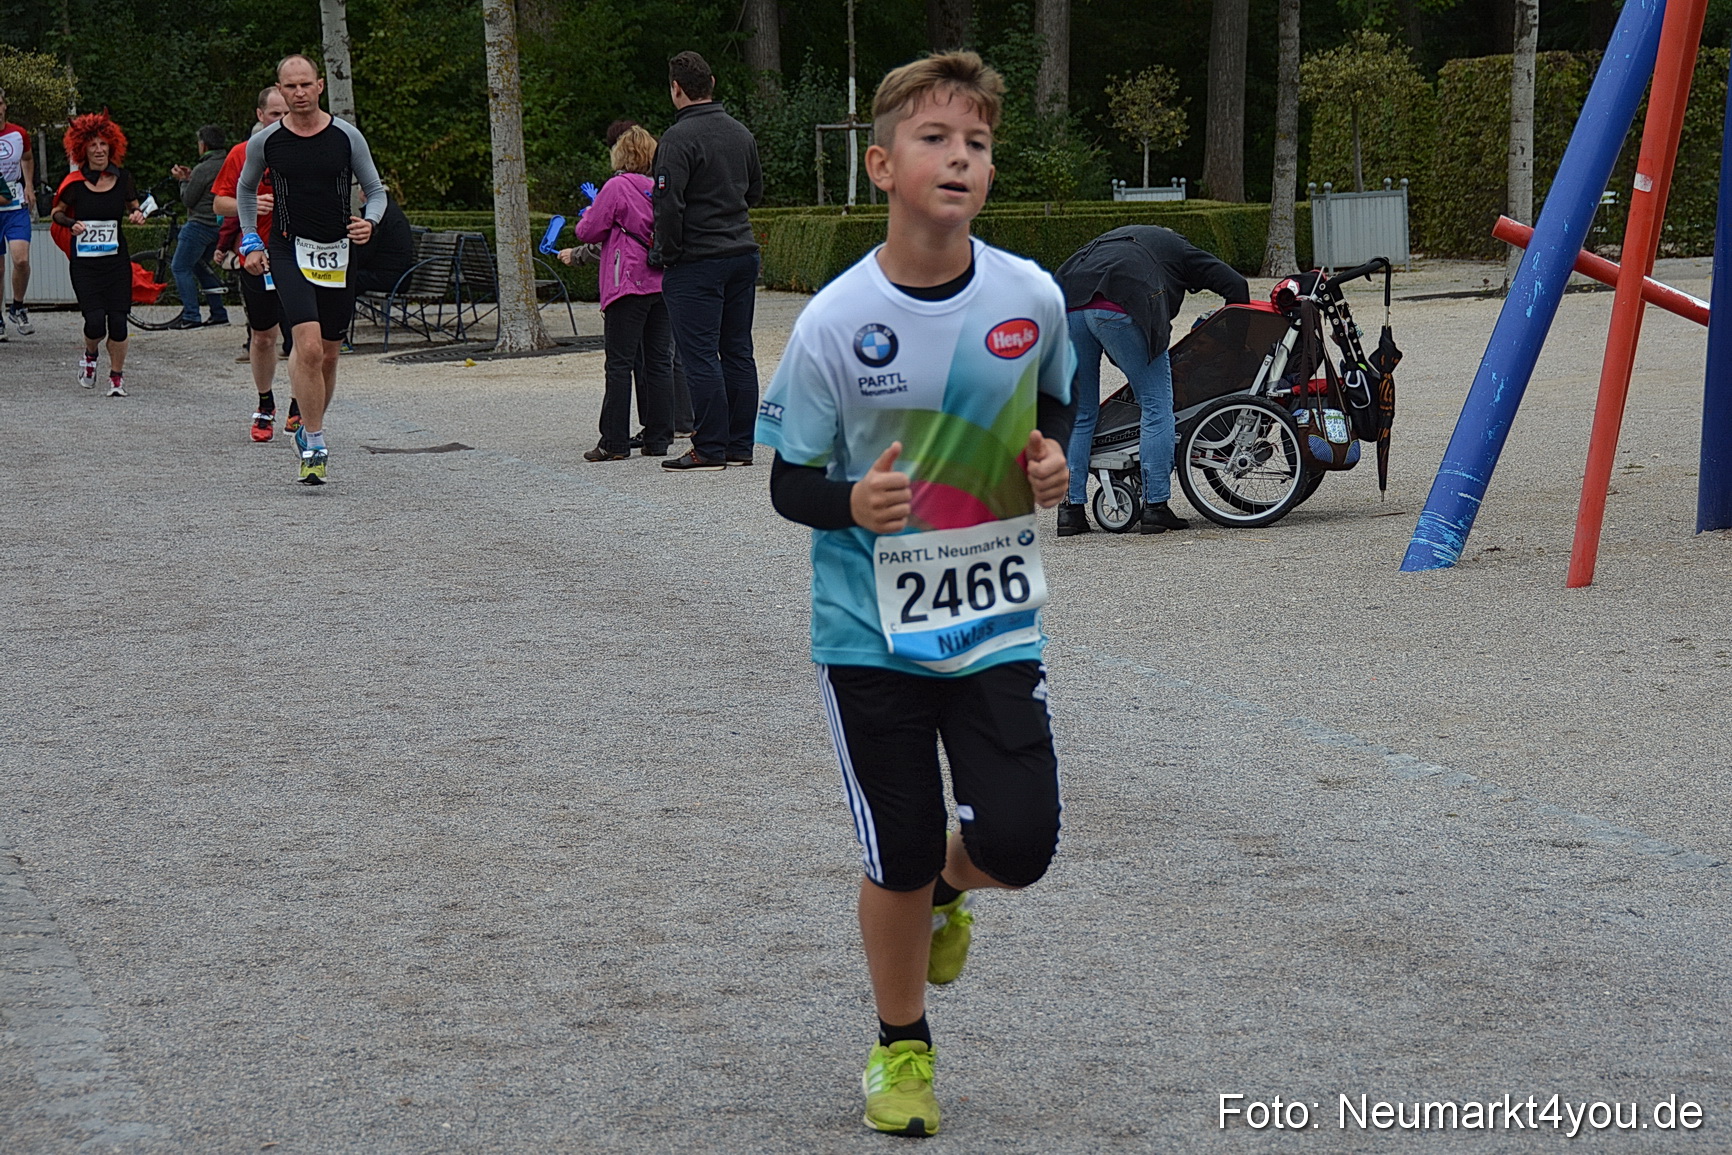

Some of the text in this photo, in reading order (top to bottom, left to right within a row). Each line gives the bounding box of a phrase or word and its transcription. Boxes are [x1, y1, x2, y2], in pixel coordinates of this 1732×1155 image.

[80, 229, 115, 243] 2257
[296, 241, 340, 251] PARTL Neumarkt
[306, 251, 338, 269] 163
[311, 271, 332, 280] Martin
[858, 371, 907, 389] PARTL
[860, 384, 908, 397] Neumarkt
[879, 535, 1011, 565] PARTL Neumarkt
[896, 555, 1030, 625] 2466
[937, 620, 995, 655] Niklas
